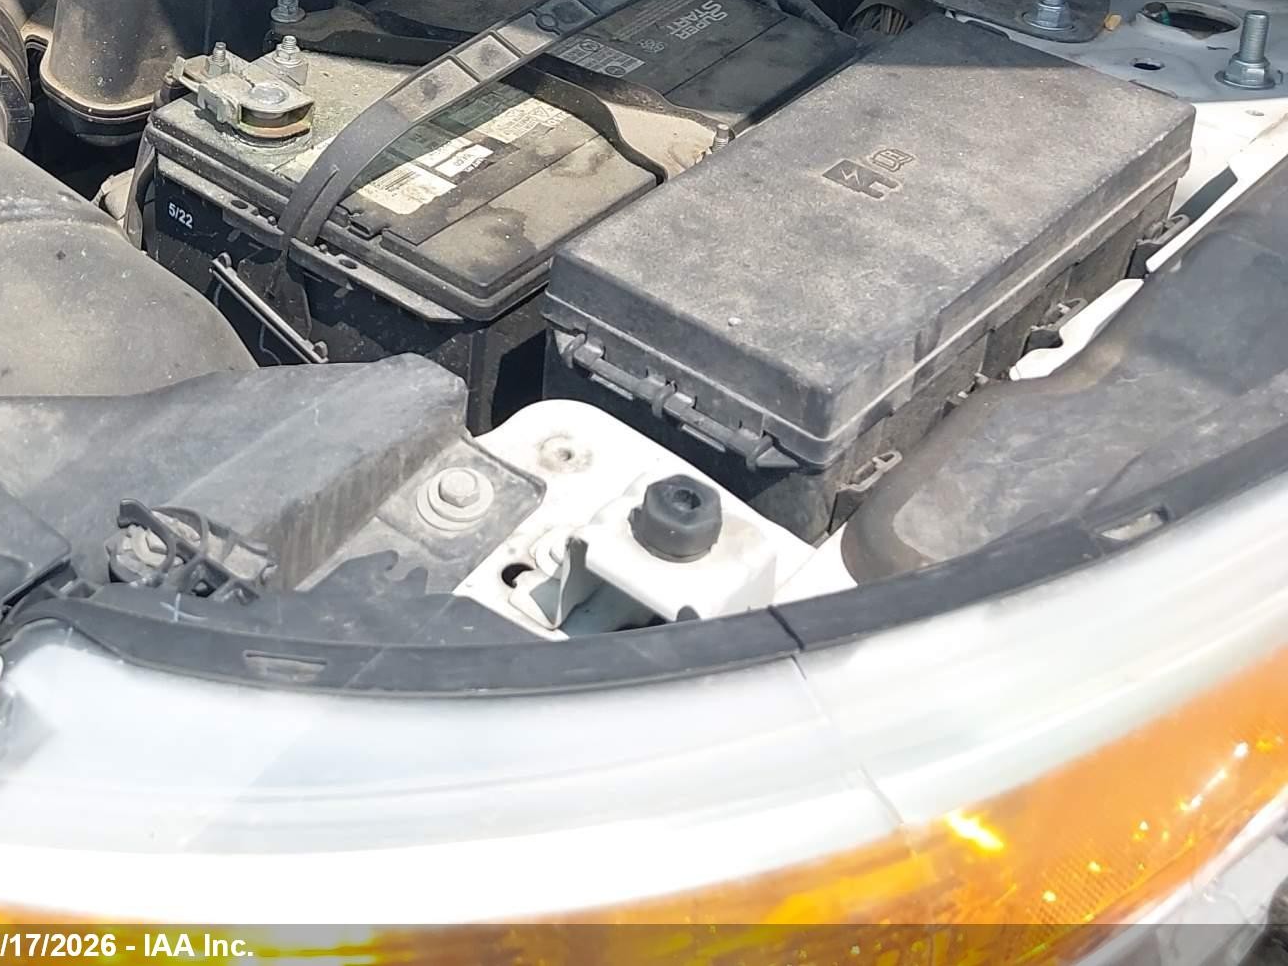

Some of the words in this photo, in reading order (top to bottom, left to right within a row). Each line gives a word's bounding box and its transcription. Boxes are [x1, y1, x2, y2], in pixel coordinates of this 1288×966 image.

[667, 0, 722, 35] START
[675, 11, 728, 40] SUPER
[169, 202, 192, 229] 5/22
